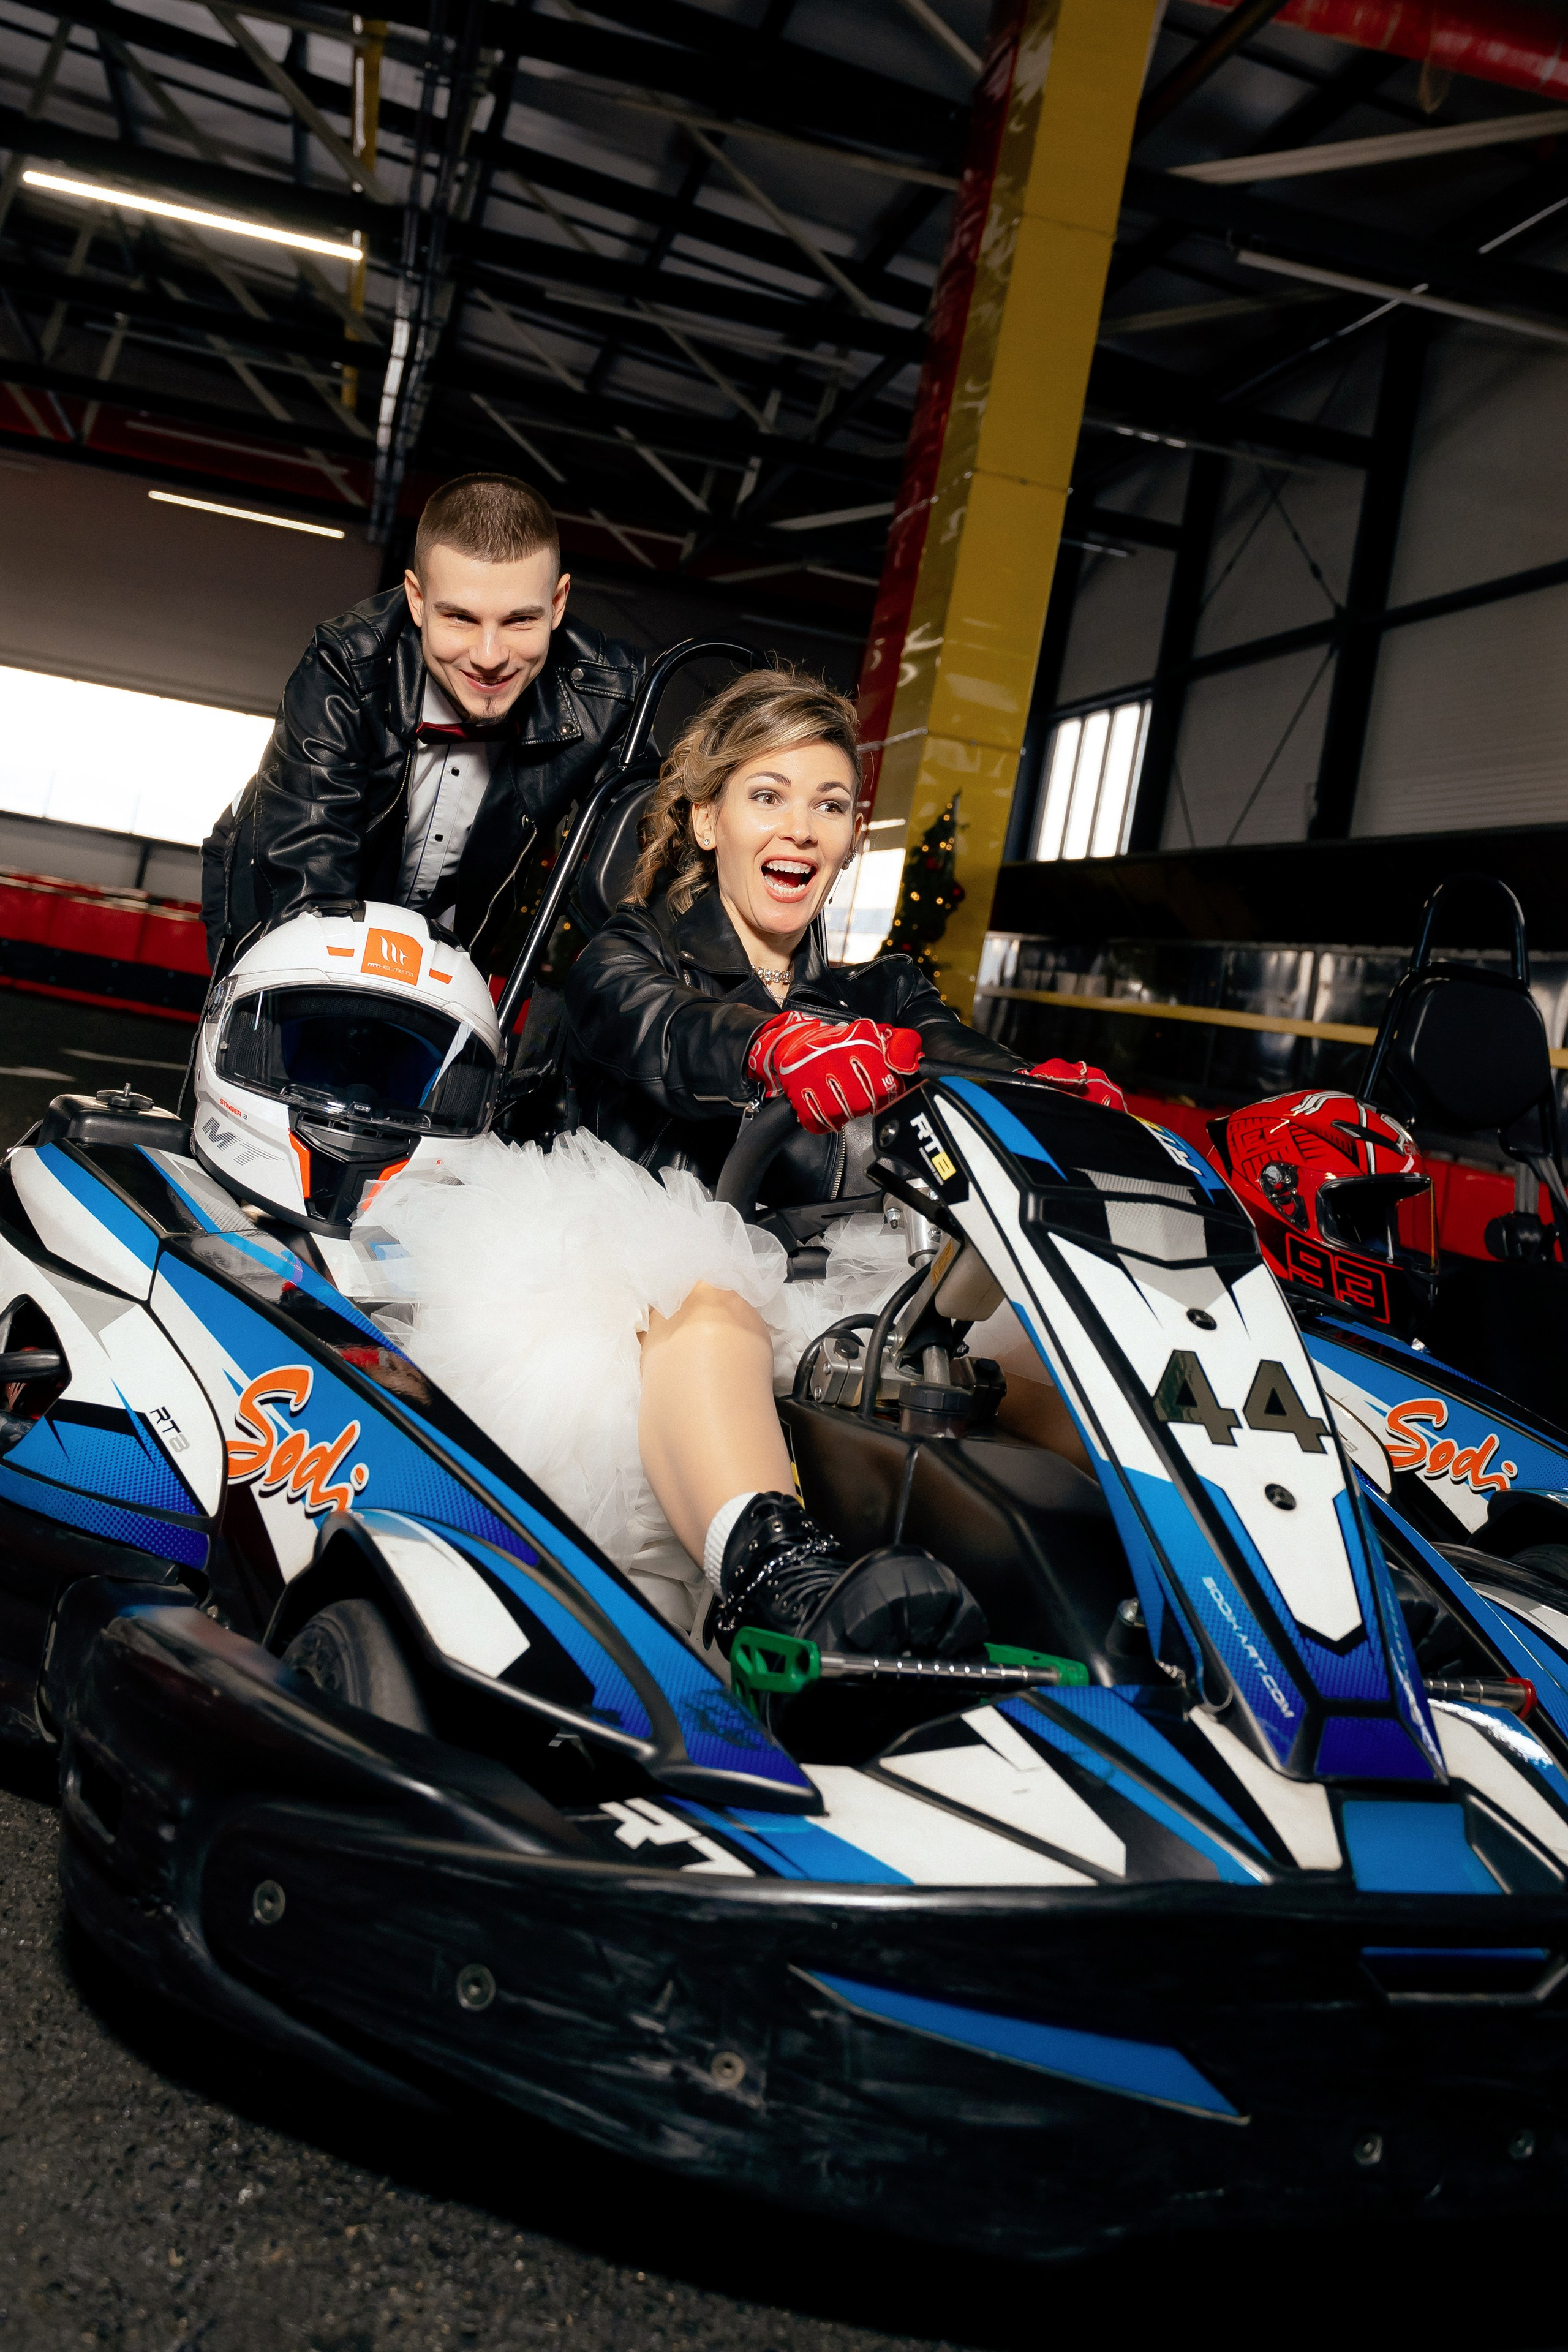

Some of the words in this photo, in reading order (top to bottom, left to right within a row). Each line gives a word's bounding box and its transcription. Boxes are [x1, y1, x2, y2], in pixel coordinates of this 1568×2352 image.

[220, 1098, 242, 1117] STINGER
[910, 1112, 957, 1181] RT8
[1286, 1232, 1390, 1324] 93
[149, 1406, 190, 1453] RT8
[226, 1365, 369, 1514] Sodi
[1153, 1349, 1332, 1455] 44
[1384, 1398, 1518, 1493] Sodi
